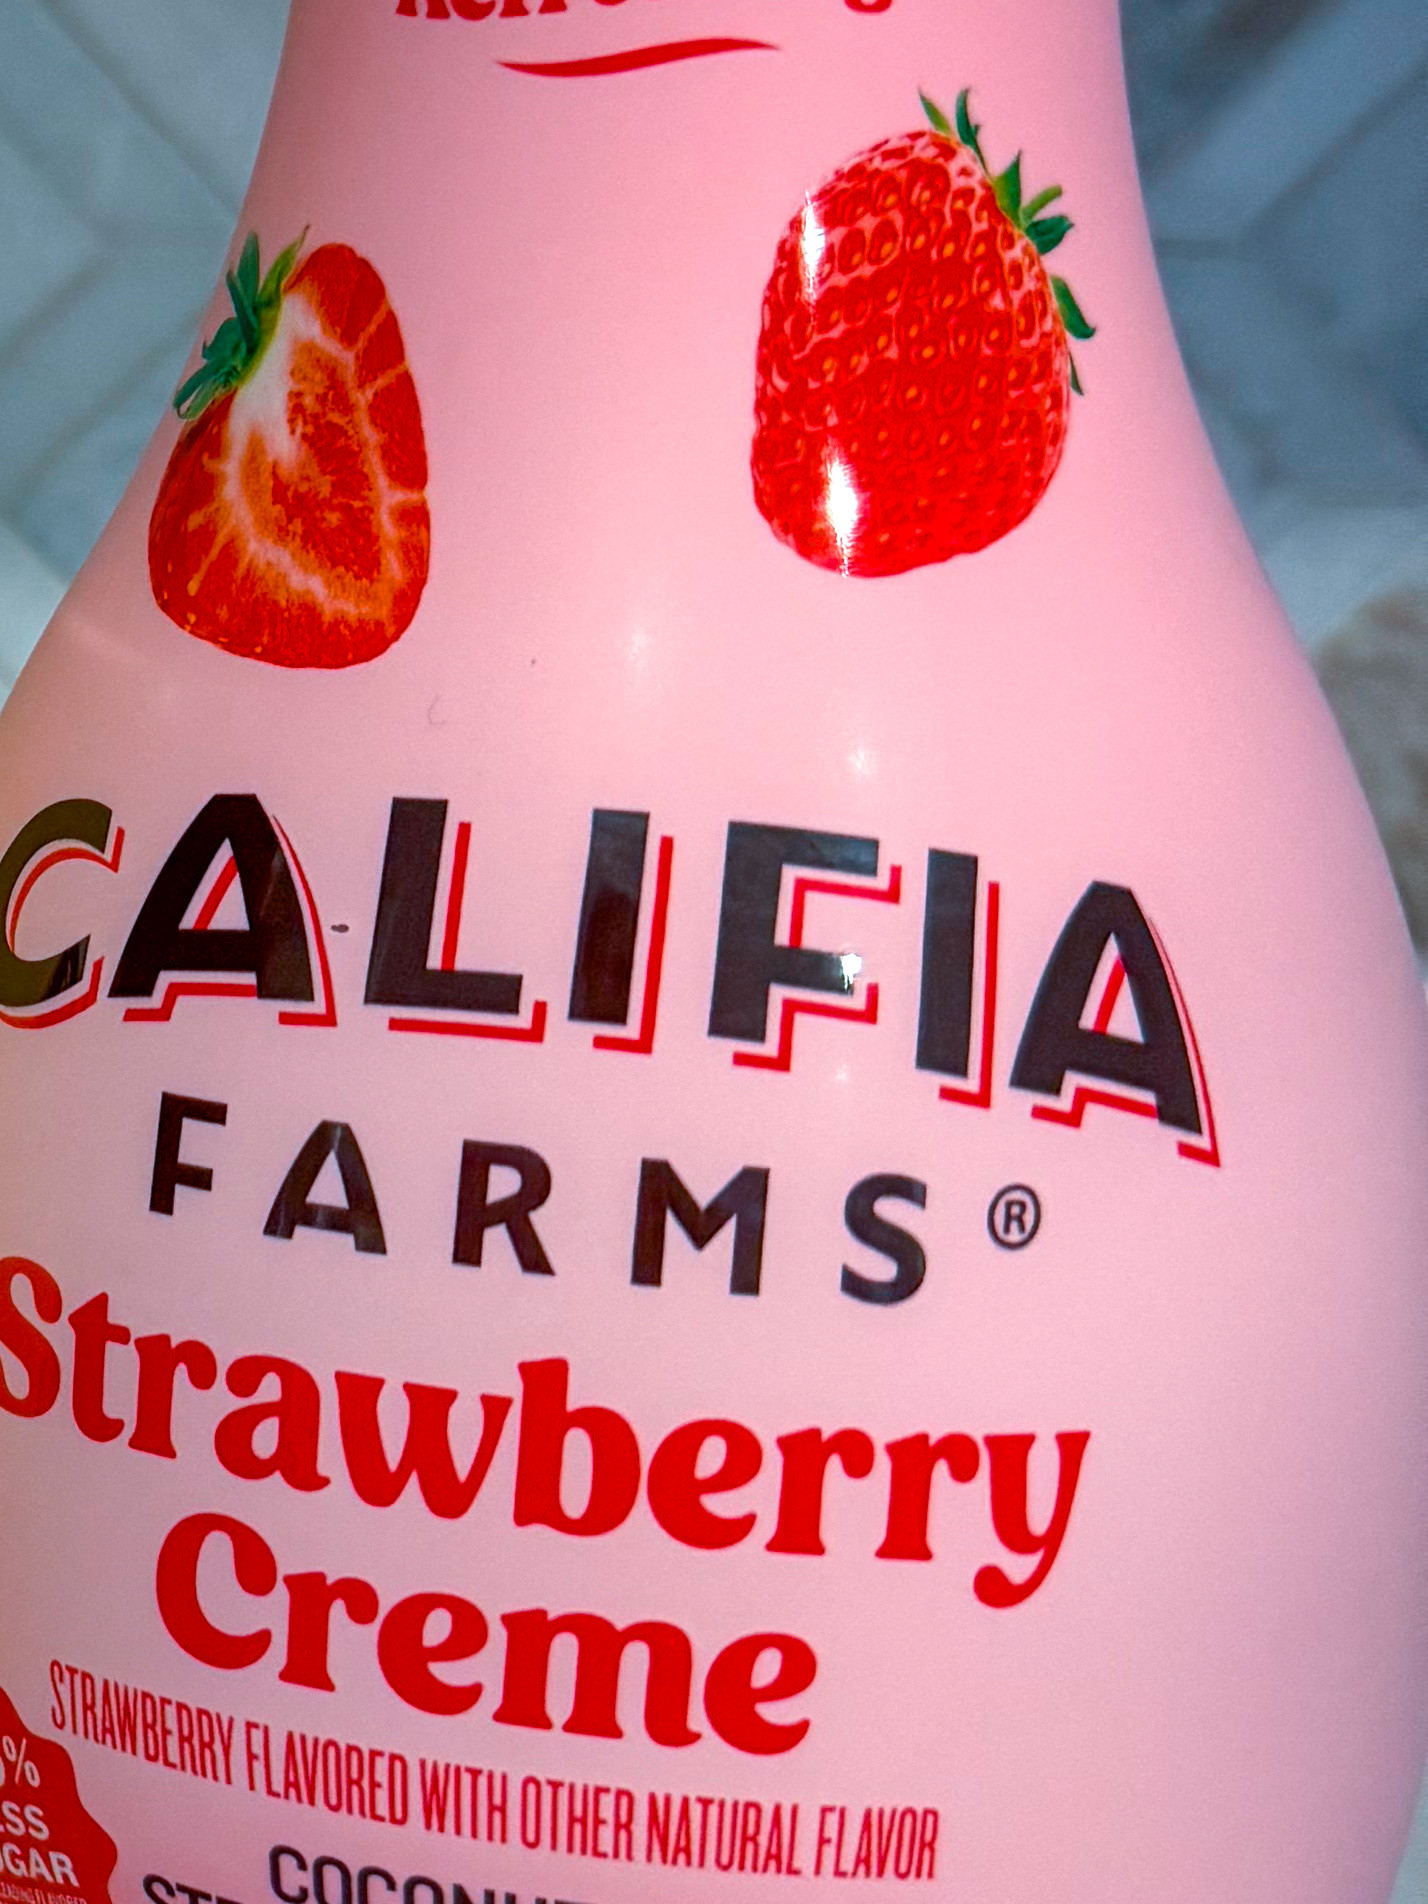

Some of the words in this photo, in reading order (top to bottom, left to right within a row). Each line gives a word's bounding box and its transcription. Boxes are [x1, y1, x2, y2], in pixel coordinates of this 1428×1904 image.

[155, 1510, 819, 1756] Creme
[49, 1658, 235, 1786] STRAWBERRY
[244, 1720, 409, 1826] FLAVORED
[418, 1757, 508, 1845] WITH
[520, 1775, 634, 1862] OTHER
[645, 1792, 801, 1876] NATURAL
[814, 1805, 939, 1880] FLAVOR
